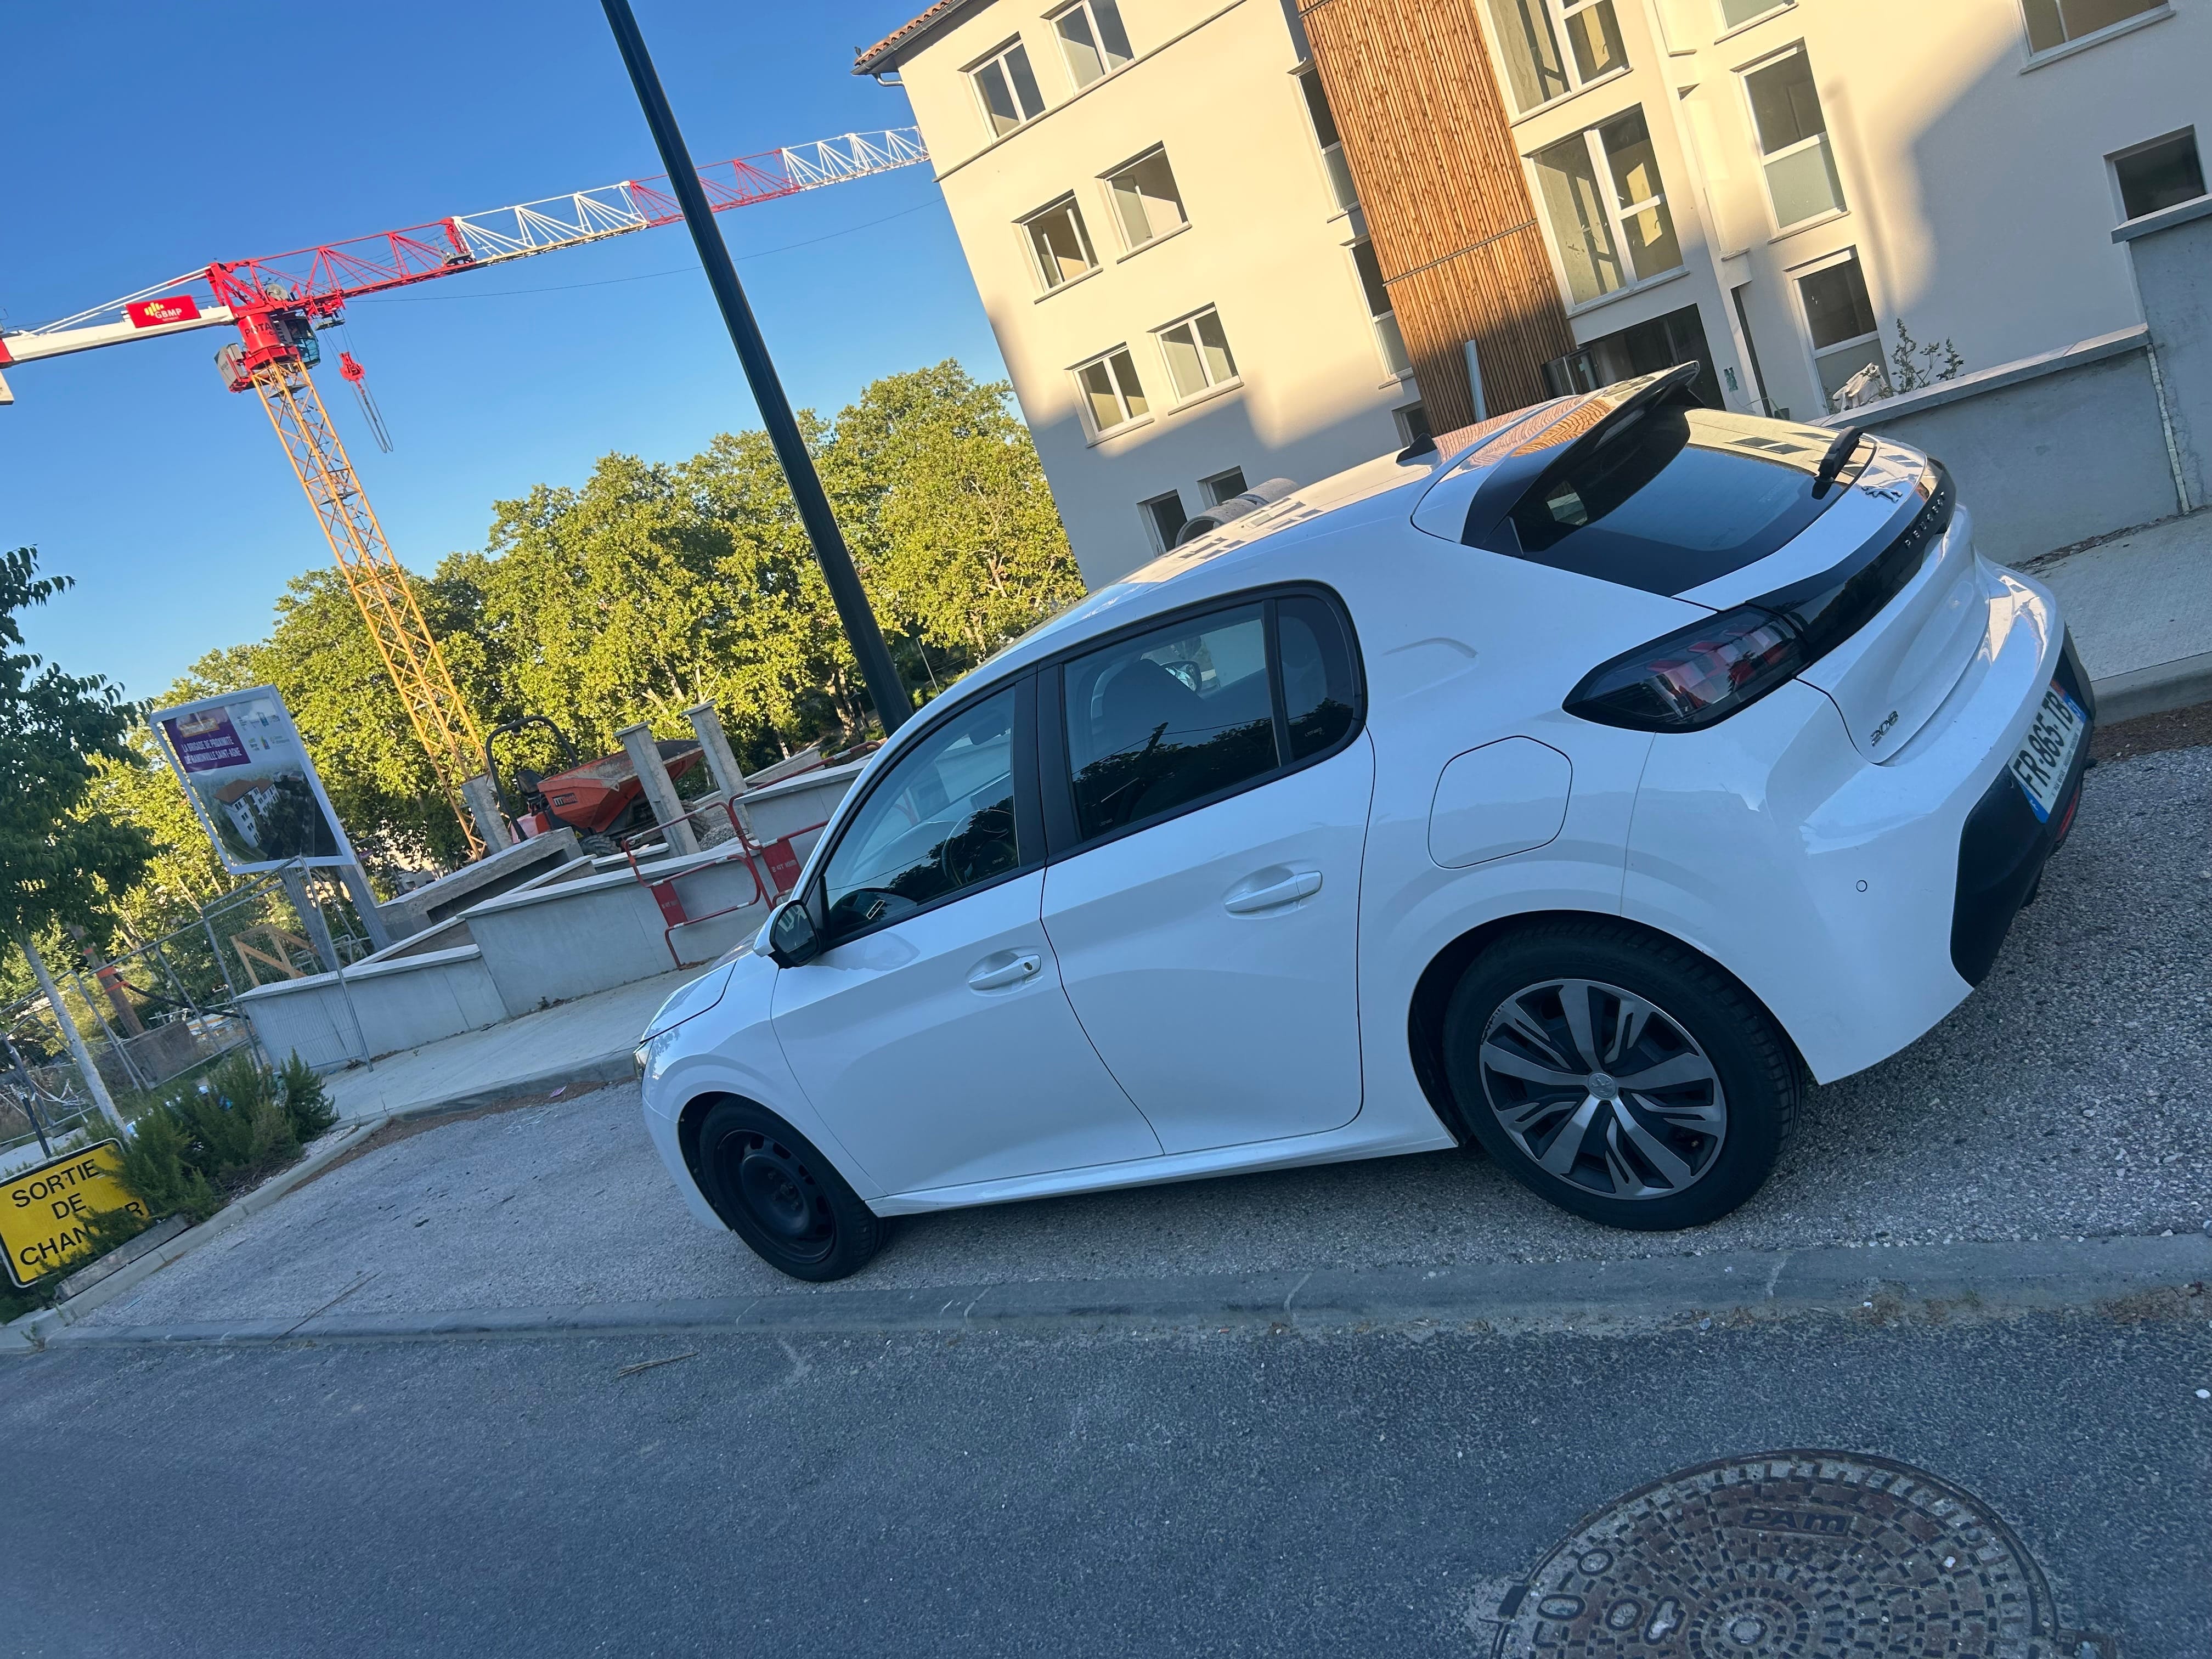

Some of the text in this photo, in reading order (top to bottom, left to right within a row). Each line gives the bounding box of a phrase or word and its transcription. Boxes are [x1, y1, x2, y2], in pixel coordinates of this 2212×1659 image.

[155, 308, 182, 319] GBMP
[245, 323, 274, 337] POTA
[1905, 491, 1945, 549] PEUGEOT
[1870, 710, 1899, 747] 208
[181, 744, 189, 753] LA
[184, 755, 193, 764] DE
[12, 1159, 101, 1207] SORTIE
[51, 1193, 87, 1220] DE
[20, 1201, 144, 1265] CHANR
